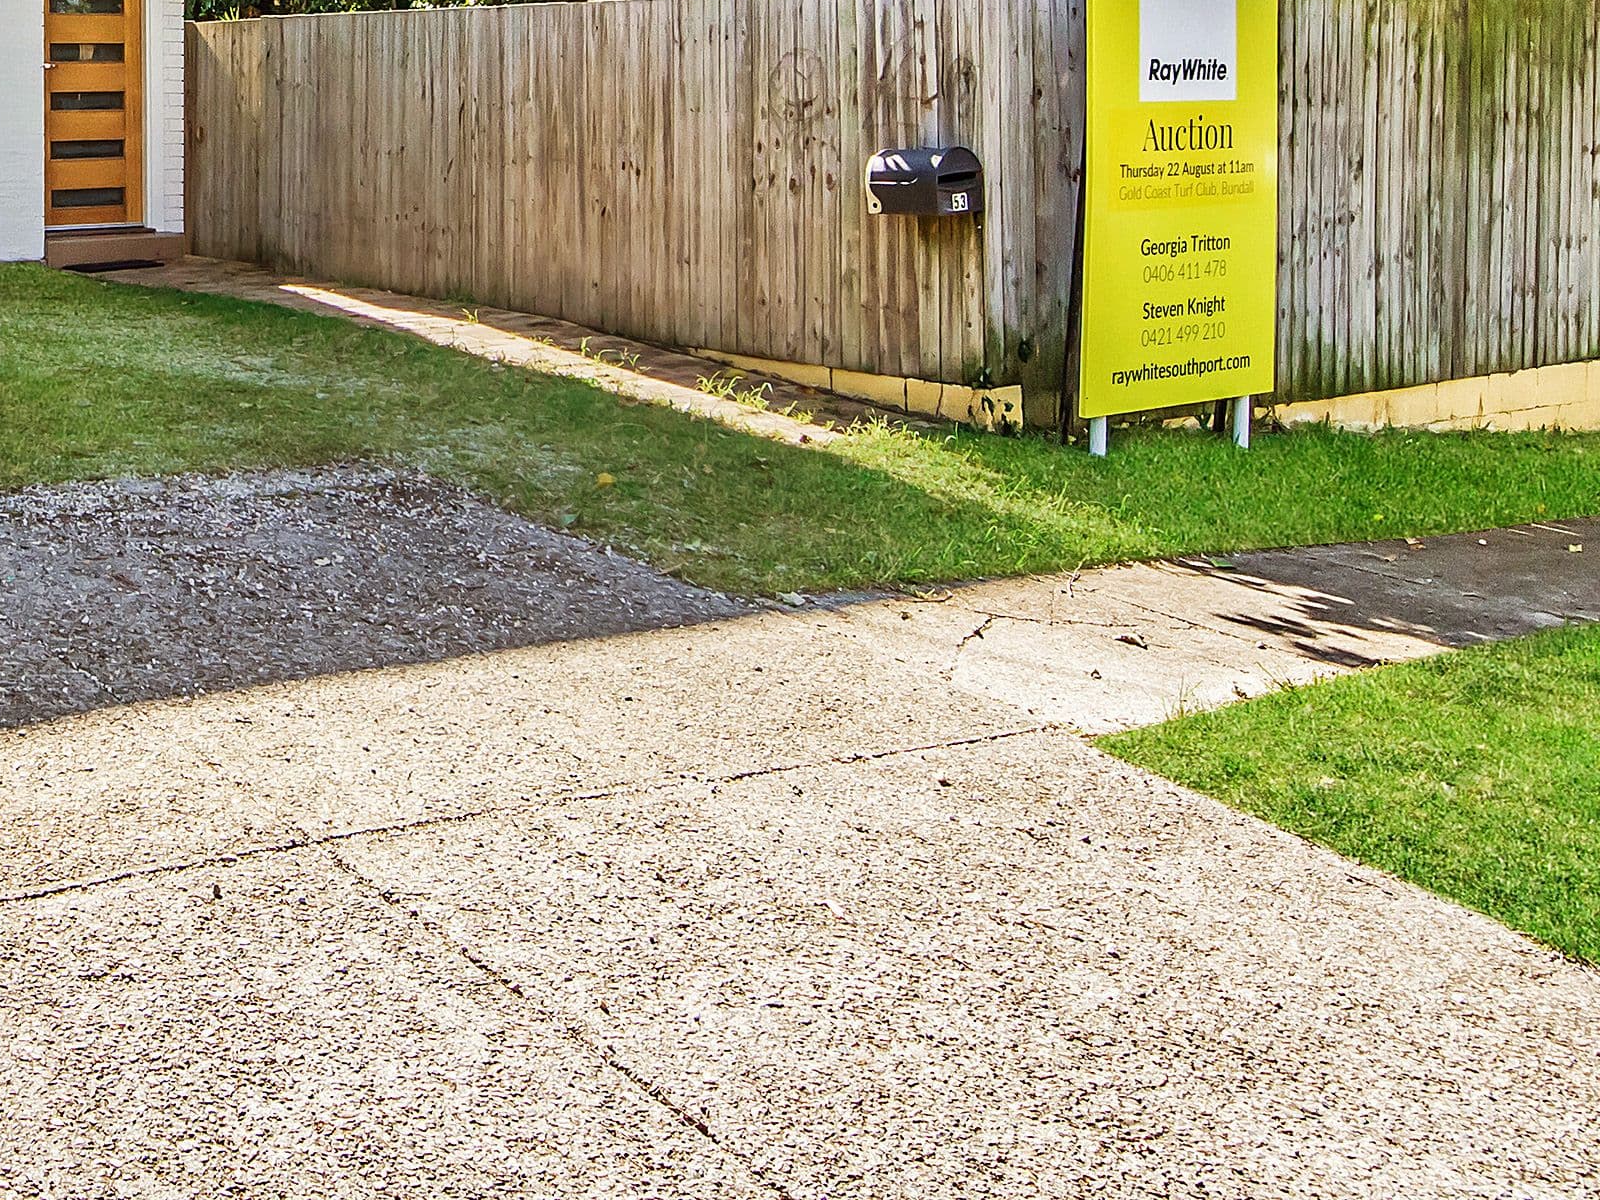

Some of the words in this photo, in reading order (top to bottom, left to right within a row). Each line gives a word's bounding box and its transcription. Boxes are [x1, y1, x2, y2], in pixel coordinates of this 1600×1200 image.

[1142, 114, 1234, 152] Auction
[1120, 163, 1164, 180] Thursday
[1167, 162, 1180, 177] 22
[1182, 161, 1215, 179] August
[1217, 162, 1227, 174] at
[1229, 160, 1255, 174] 11am
[953, 194, 966, 210] 53
[1119, 185, 1142, 201] Gold
[1144, 184, 1172, 200] Coast
[1174, 182, 1194, 198] Turf
[1221, 180, 1255, 195] Bundall
[1140, 236, 1188, 258] Georgia
[1190, 234, 1231, 252] Tritton
[1143, 264, 1175, 284] 0406
[1177, 261, 1200, 280] 411
[1203, 259, 1227, 277] 478
[1142, 301, 1184, 320] Steven
[1187, 295, 1226, 318] Knight
[1141, 327, 1172, 347] 0421
[1175, 323, 1200, 342] 499
[1202, 321, 1226, 340] 210
[1111, 355, 1251, 387] raywhitesouthport.com
